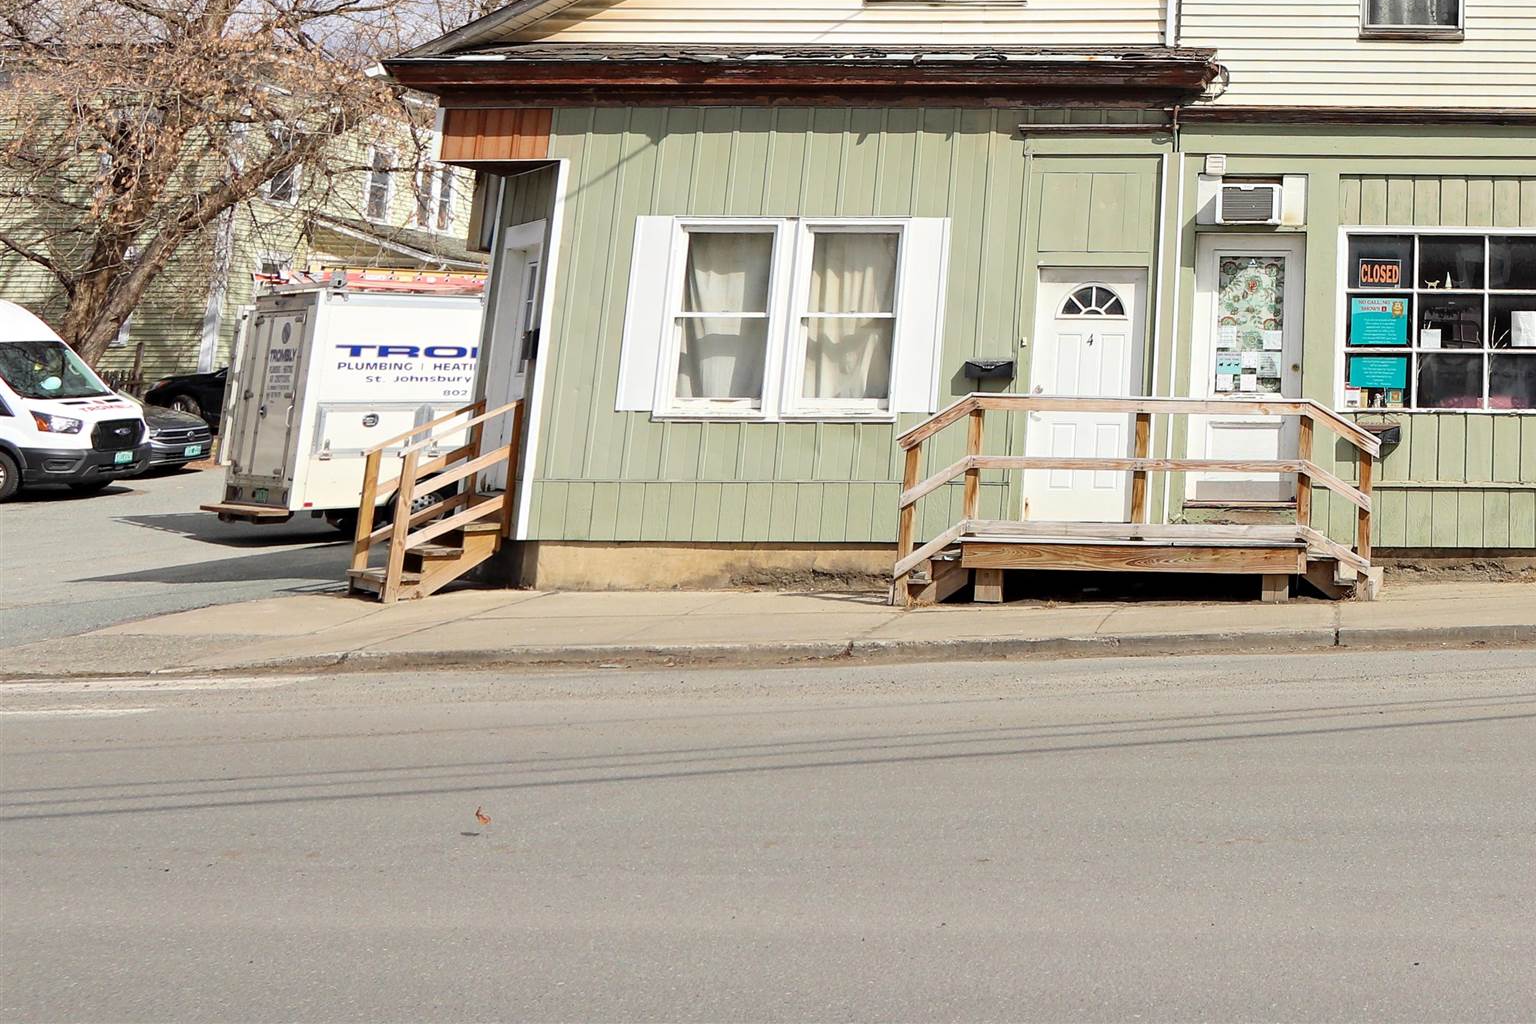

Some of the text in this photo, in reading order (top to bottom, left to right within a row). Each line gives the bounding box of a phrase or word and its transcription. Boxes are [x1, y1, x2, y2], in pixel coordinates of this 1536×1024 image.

[1361, 264, 1399, 283] CLOSED
[1086, 333, 1093, 346] 4
[337, 362, 476, 371] PLUMBING HEATI
[394, 375, 471, 383] Johnsbury
